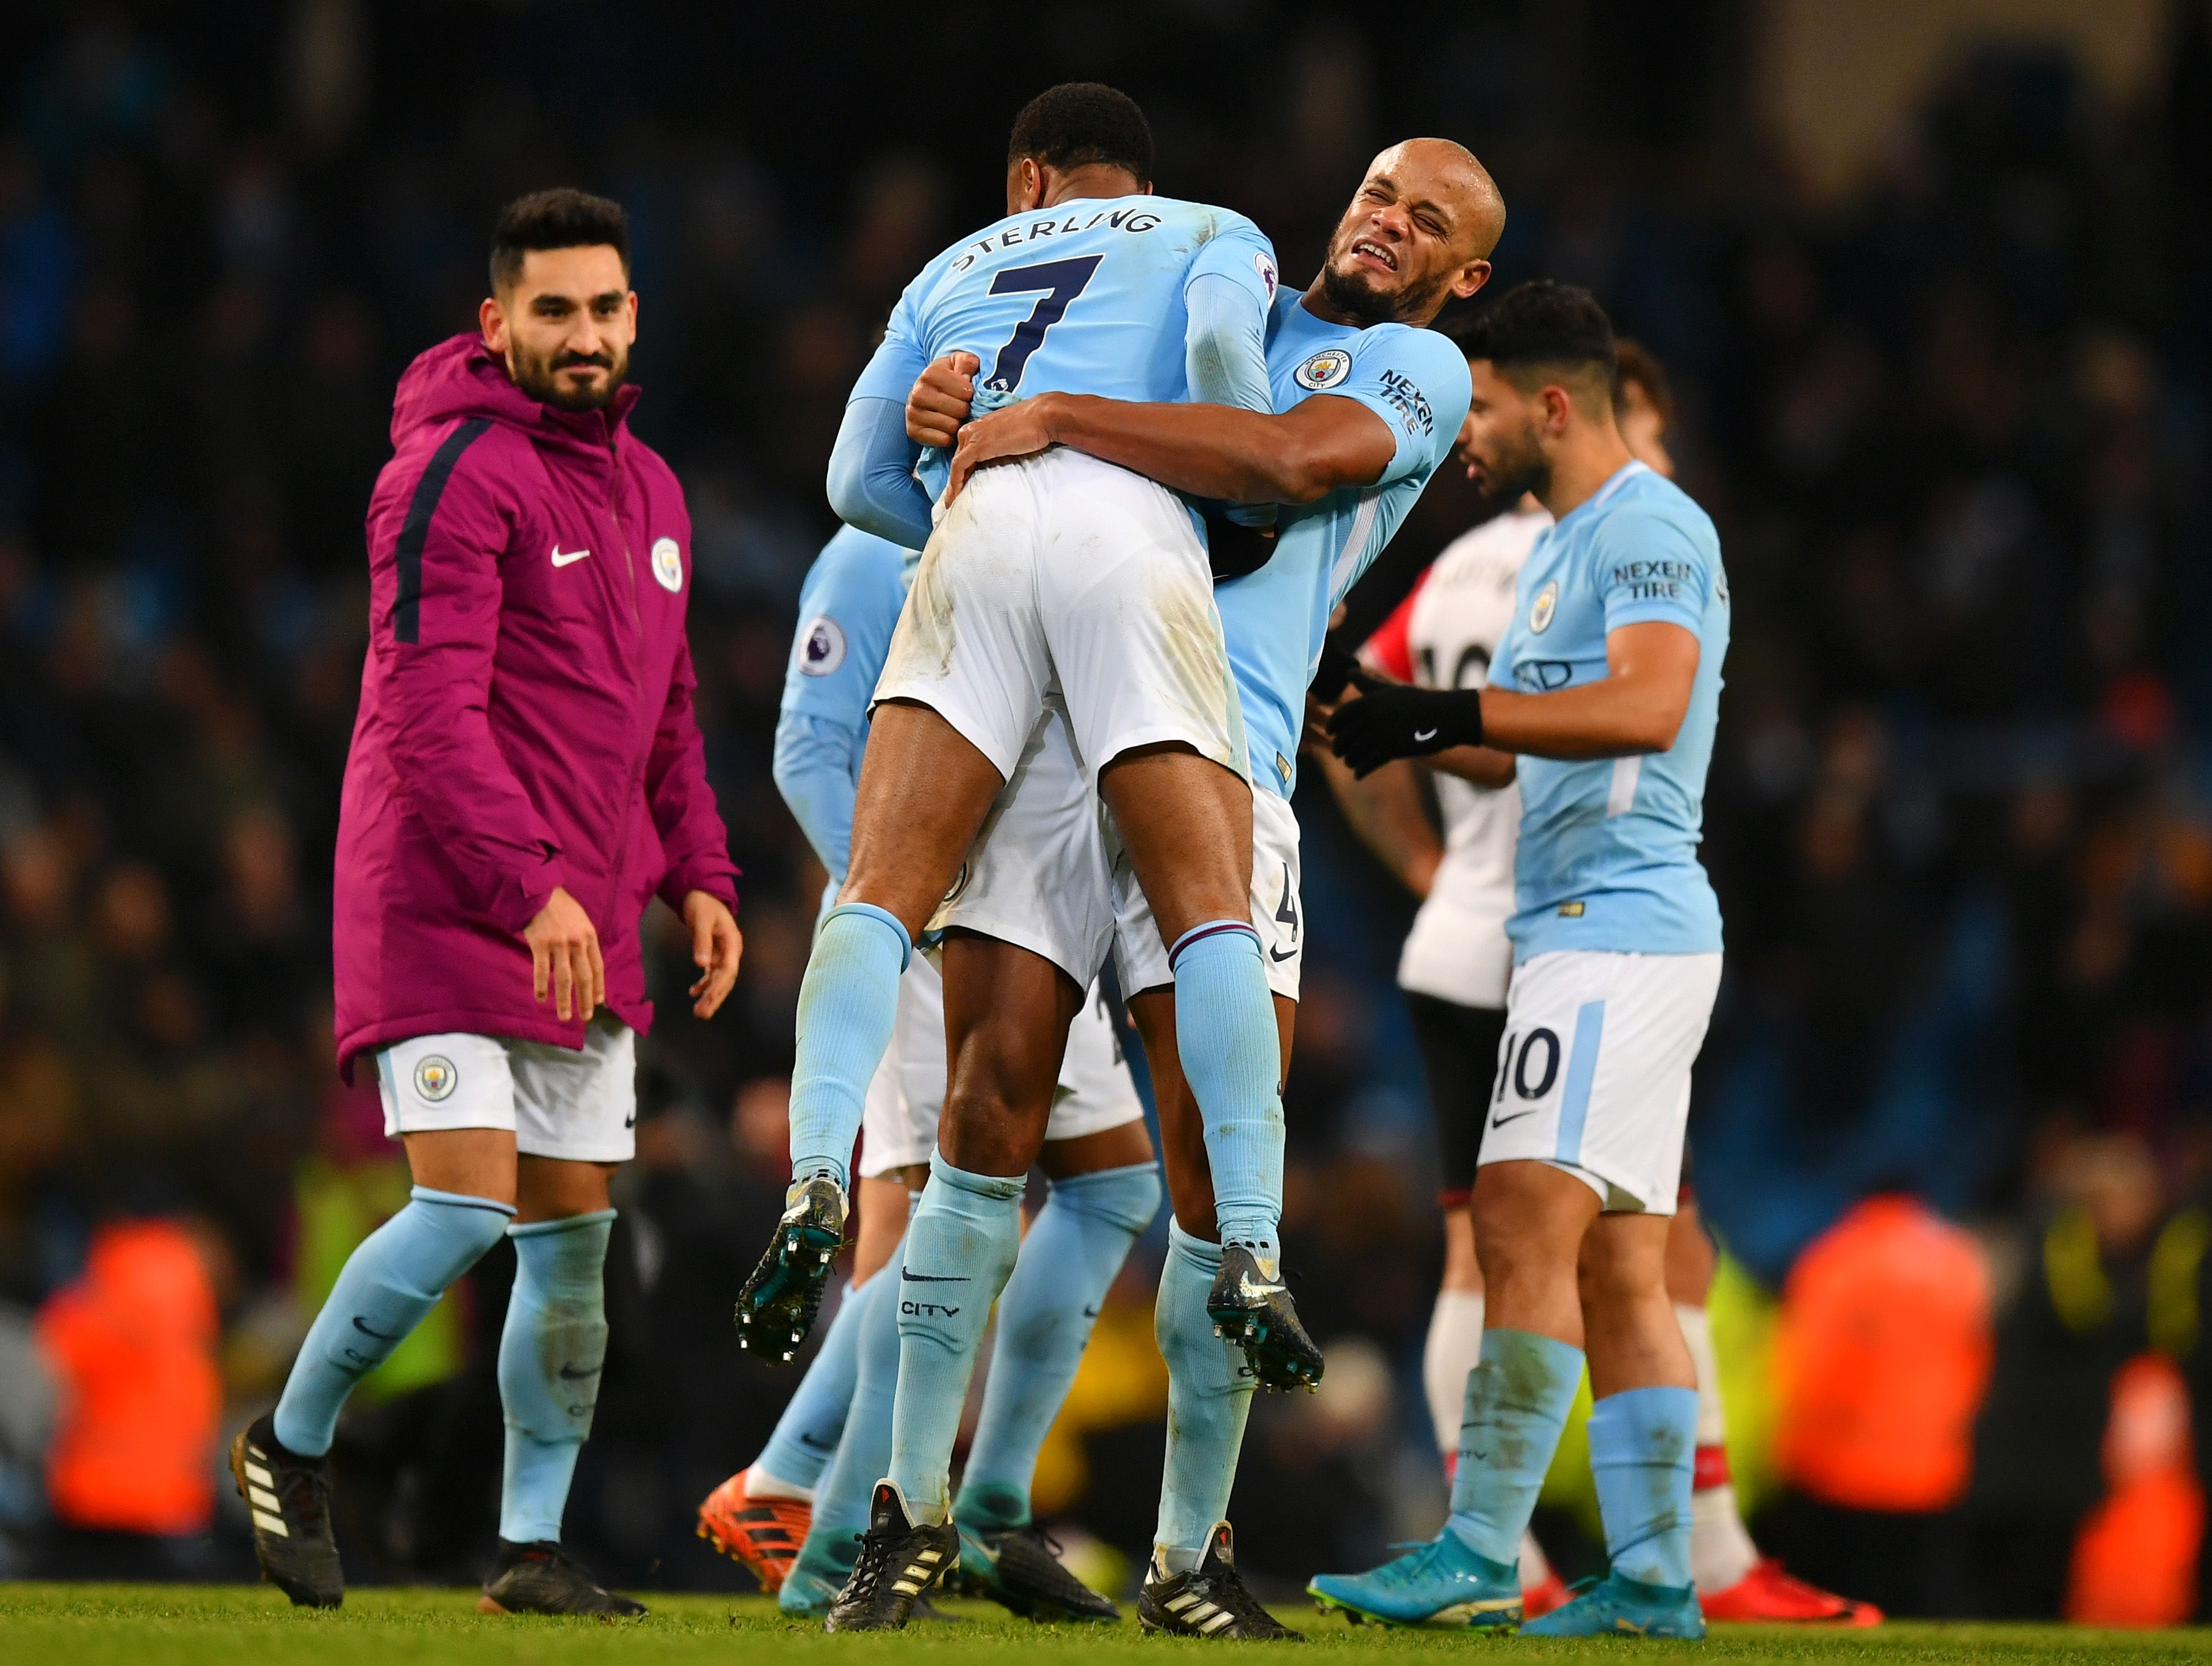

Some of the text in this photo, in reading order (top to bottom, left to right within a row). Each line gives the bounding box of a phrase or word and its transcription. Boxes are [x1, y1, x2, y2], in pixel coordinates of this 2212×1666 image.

[952, 208, 1162, 272] STERLING
[983, 254, 1104, 394] 7
[1306, 352, 1347, 366] MANCHESTER
[1379, 369, 1434, 437] NEXEN
[1381, 384, 1419, 436] TIRE
[1614, 561, 1690, 582] NEXEN
[1629, 582, 1680, 599] TIRE
[1276, 862, 1298, 942] 4
[1497, 1027, 1560, 1103] 10
[901, 1301, 960, 1317] CITY
